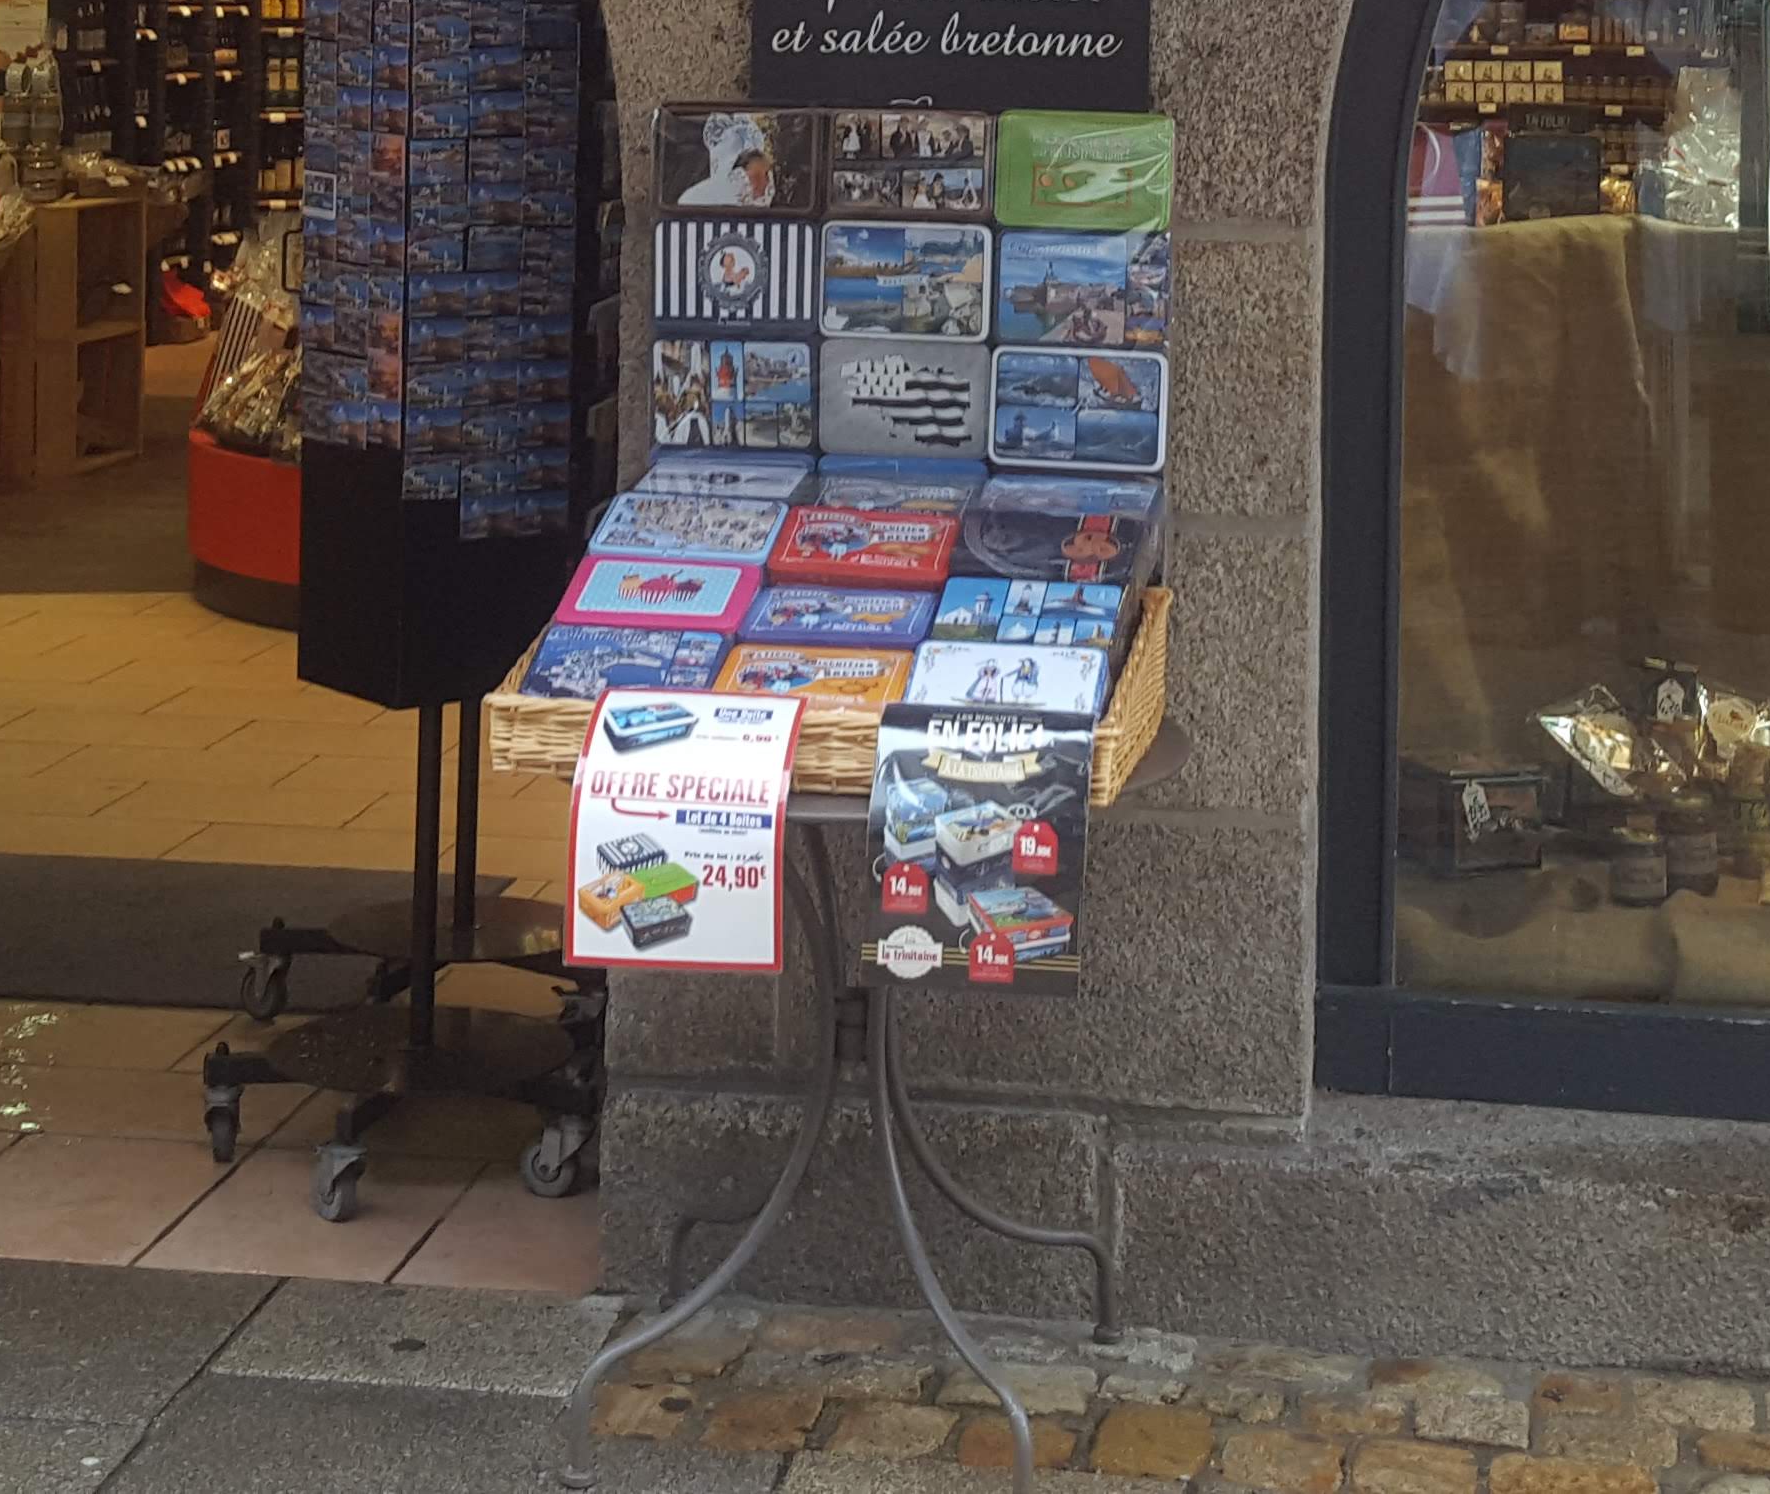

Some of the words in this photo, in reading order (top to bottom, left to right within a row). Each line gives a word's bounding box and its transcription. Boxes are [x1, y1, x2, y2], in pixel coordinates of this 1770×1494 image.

[771, 18, 813, 54] et
[819, 9, 930, 56] salée
[940, 11, 1123, 59] bretonne
[927, 719, 960, 749] EN
[590, 769, 660, 797] OFFRE
[685, 810, 701, 825] Lot
